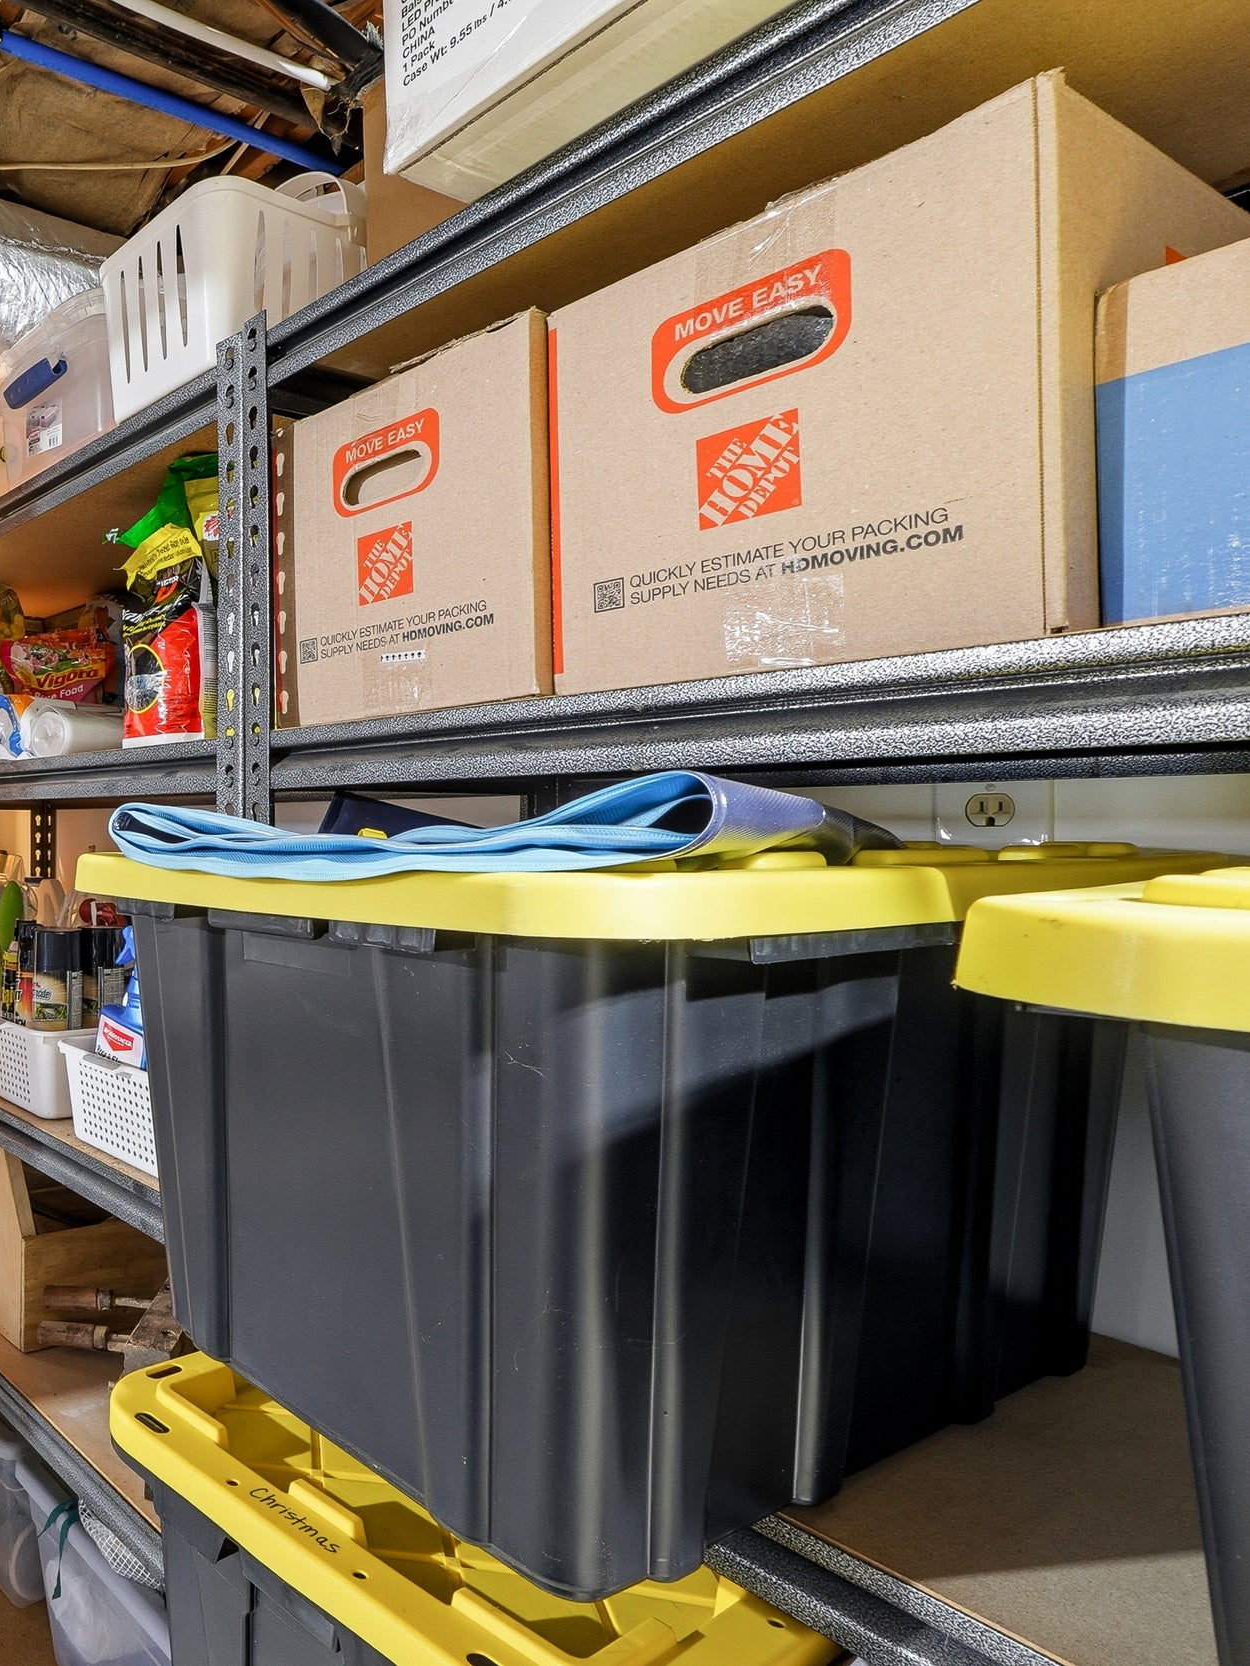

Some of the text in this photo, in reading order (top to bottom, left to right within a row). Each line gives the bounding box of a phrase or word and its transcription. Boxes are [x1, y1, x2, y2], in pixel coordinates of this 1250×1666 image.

[402, 9, 421, 32] LED
[402, 27, 416, 46] PO
[402, 26, 435, 58] CHINA
[403, 62, 428, 86] Case
[449, 22, 473, 48] 9.55
[474, 14, 488, 29] lbs
[497, 0, 512, 8] 4.
[402, 40, 435, 72] 1 Pack
[675, 263, 823, 342] MOVE EASY
[344, 418, 426, 464] MOVE EASY
[706, 437, 748, 479] THE
[699, 414, 800, 526] HOME
[738, 446, 800, 519] DEPOT
[359, 524, 413, 603] HOME
[363, 539, 385, 569] THE
[630, 507, 949, 588] QUICKLY ESTIMATE YOUR PACKING
[630, 524, 964, 605] SUPPLY NEEDS AT HDMOVING.COM
[379, 548, 413, 599] DEPOT
[320, 599, 488, 647] QUICKLY ESTIMATE YOUR PACKING
[320, 612, 494, 660] SUPPLY NEEDS AT HDMOVING.COM
[36, 668, 99, 689] Vigora
[60, 684, 84, 699] Food
[249, 1486, 342, 1555] Christmas
